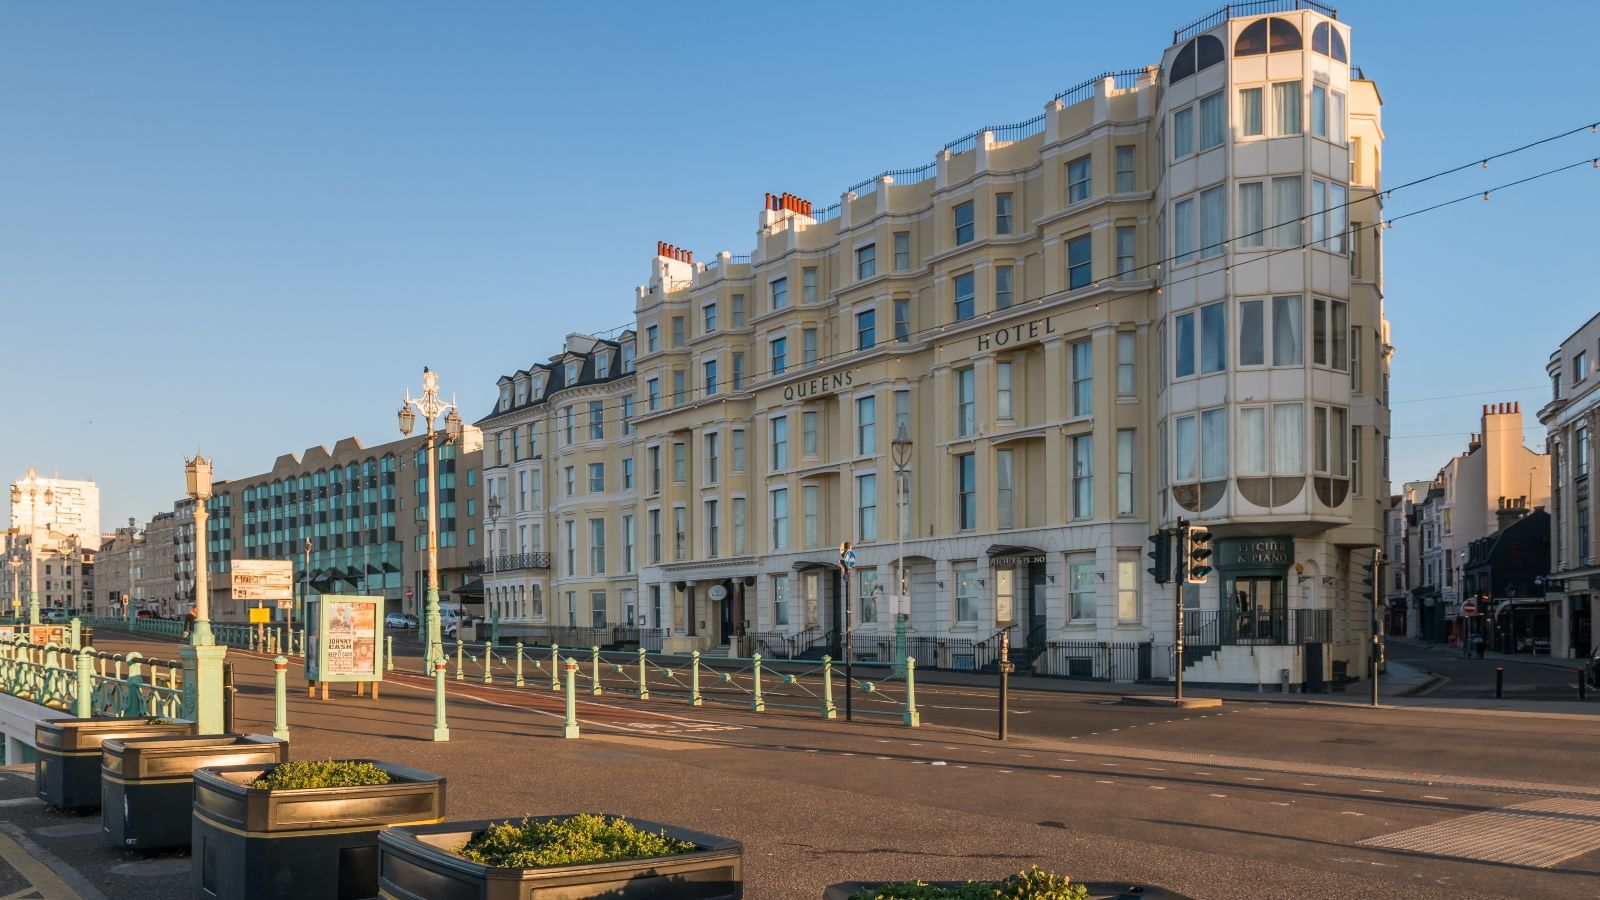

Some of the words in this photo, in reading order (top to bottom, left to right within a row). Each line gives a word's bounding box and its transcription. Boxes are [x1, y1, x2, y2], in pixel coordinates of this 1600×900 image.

[784, 371, 852, 400] QUEENS
[977, 317, 1056, 351] HOTEL
[1252, 553, 1287, 562] PIANO
